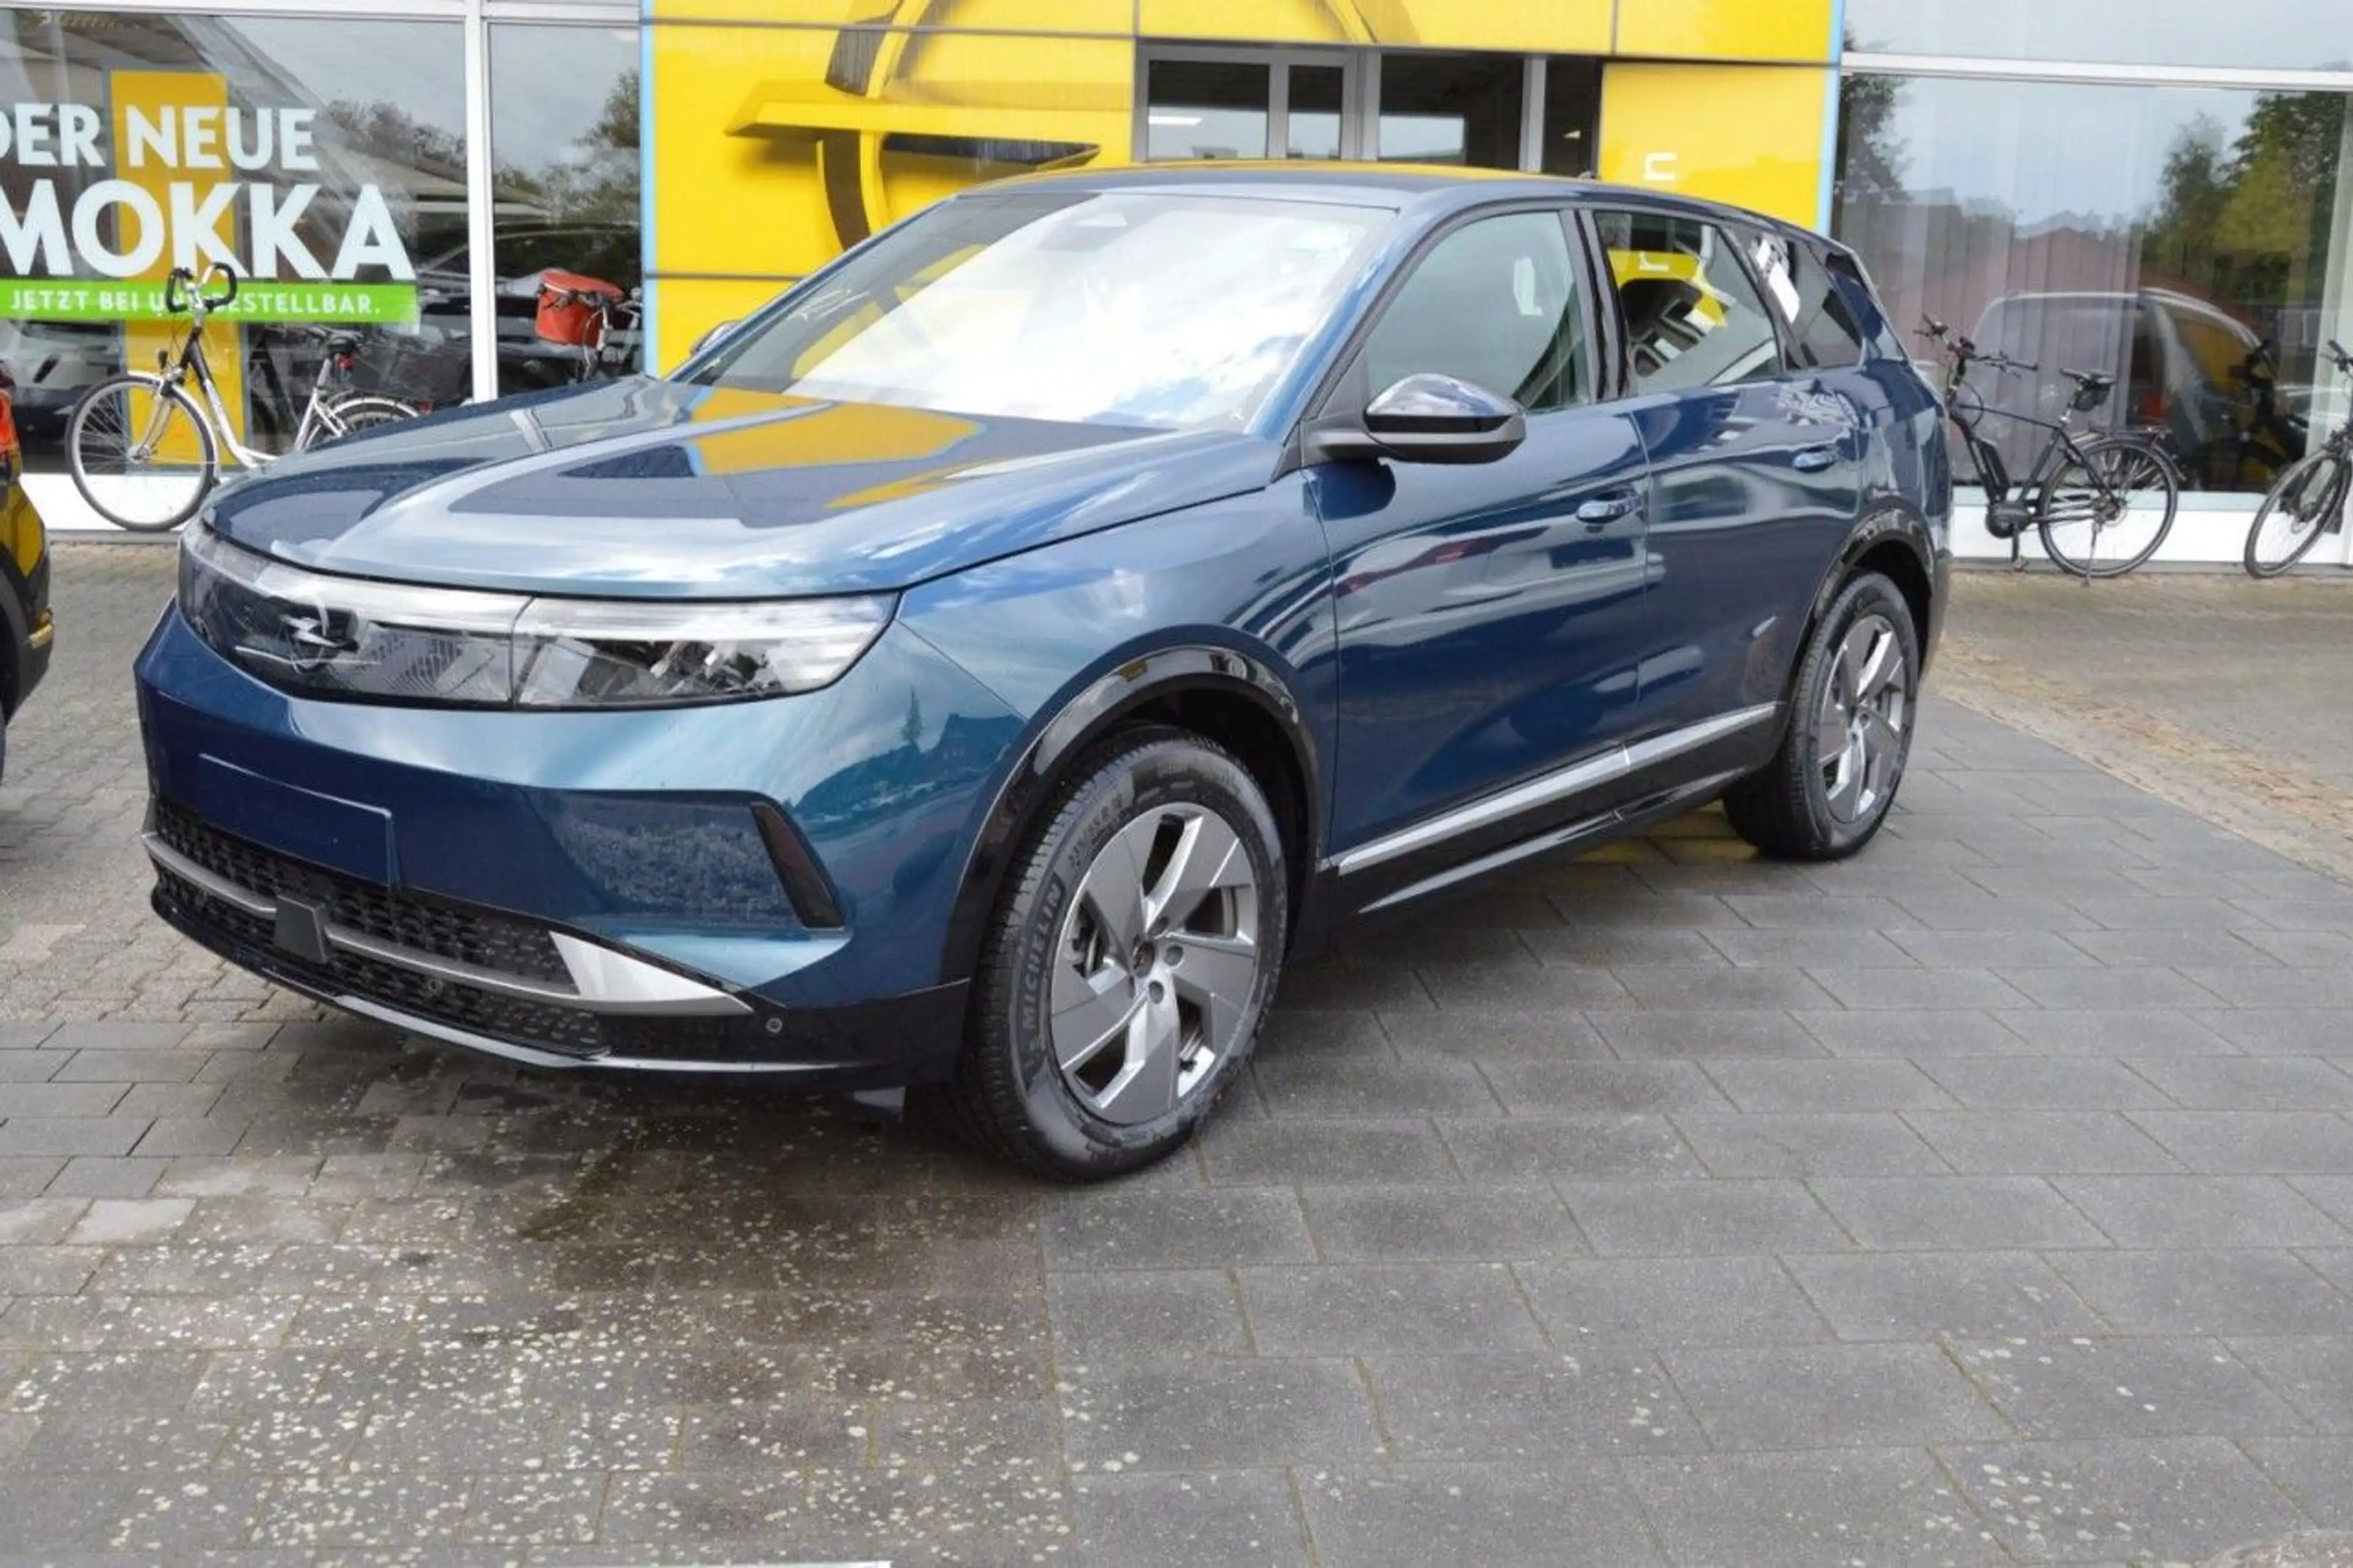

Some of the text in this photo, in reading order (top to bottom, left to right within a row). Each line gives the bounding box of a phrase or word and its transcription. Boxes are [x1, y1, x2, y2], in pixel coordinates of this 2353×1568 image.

[0, 103, 320, 170] ER NEUE
[0, 178, 417, 280] MOKKA
[11, 290, 89, 311] JETZT
[99, 290, 138, 312] BEI
[1021, 881, 1062, 1031] MICHELIN
